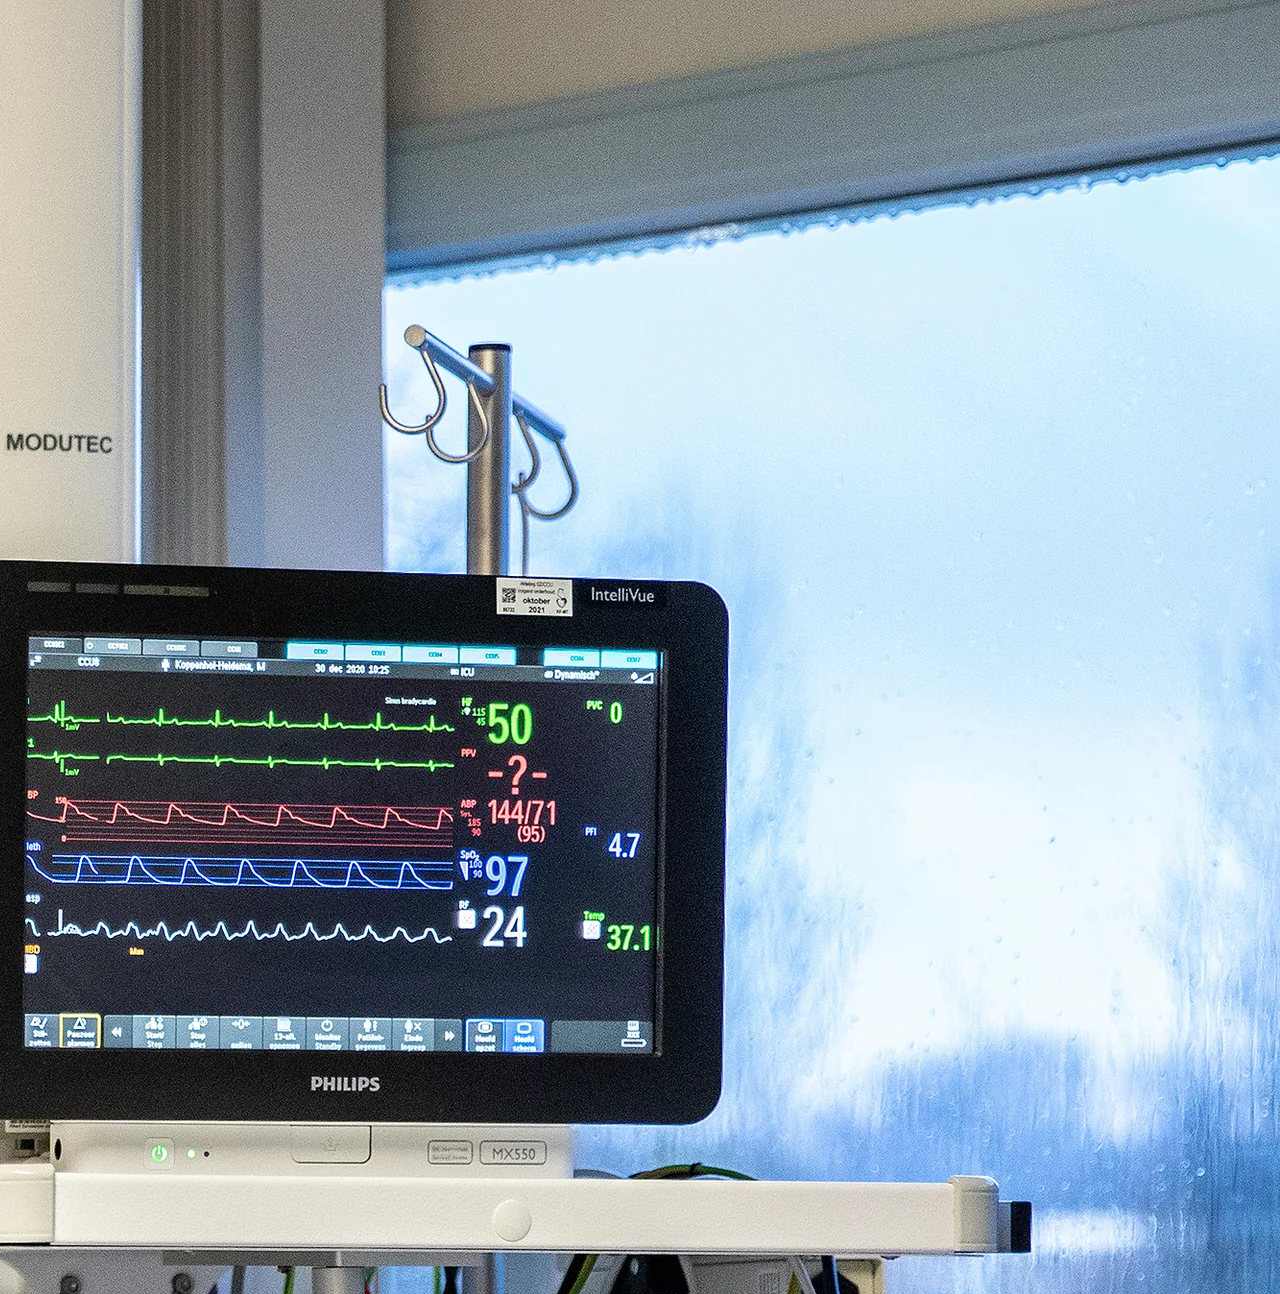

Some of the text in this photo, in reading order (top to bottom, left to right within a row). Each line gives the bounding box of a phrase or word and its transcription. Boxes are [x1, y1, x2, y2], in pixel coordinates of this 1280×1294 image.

[6, 433, 113, 454] MODUTEC
[591, 586, 655, 603] IntelliVue
[522, 597, 551, 605] oktober
[528, 606, 545, 614] 2021
[256, 662, 266, 672] M
[315, 664, 326, 674] 30
[328, 664, 343, 674] dec
[346, 664, 365, 675] 2020
[460, 667, 475, 678] ICU
[385, 697, 437, 707] Sinus bradycardie
[472, 707, 486, 717] 115
[586, 700, 623, 724] PVC 0
[461, 697, 533, 745] HF 50
[476, 717, 486, 727] 45
[65, 723, 80, 731] 1mV
[460, 748, 477, 758] PPV
[64, 769, 80, 777] 1mV
[460, 799, 557, 826] ABP 144/71
[472, 828, 482, 837] 90
[517, 825, 546, 844] (95)
[584, 826, 641, 859] PFI 4.7
[469, 860, 483, 869] 100
[473, 870, 483, 878] 90
[485, 855, 529, 897] 97
[458, 900, 528, 948] RF 24
[583, 910, 651, 951] Temp 37.1
[314, 1042, 342, 1051] Standby
[310, 1076, 381, 1092] PHILIPS
[492, 1147, 536, 1161] MX550
